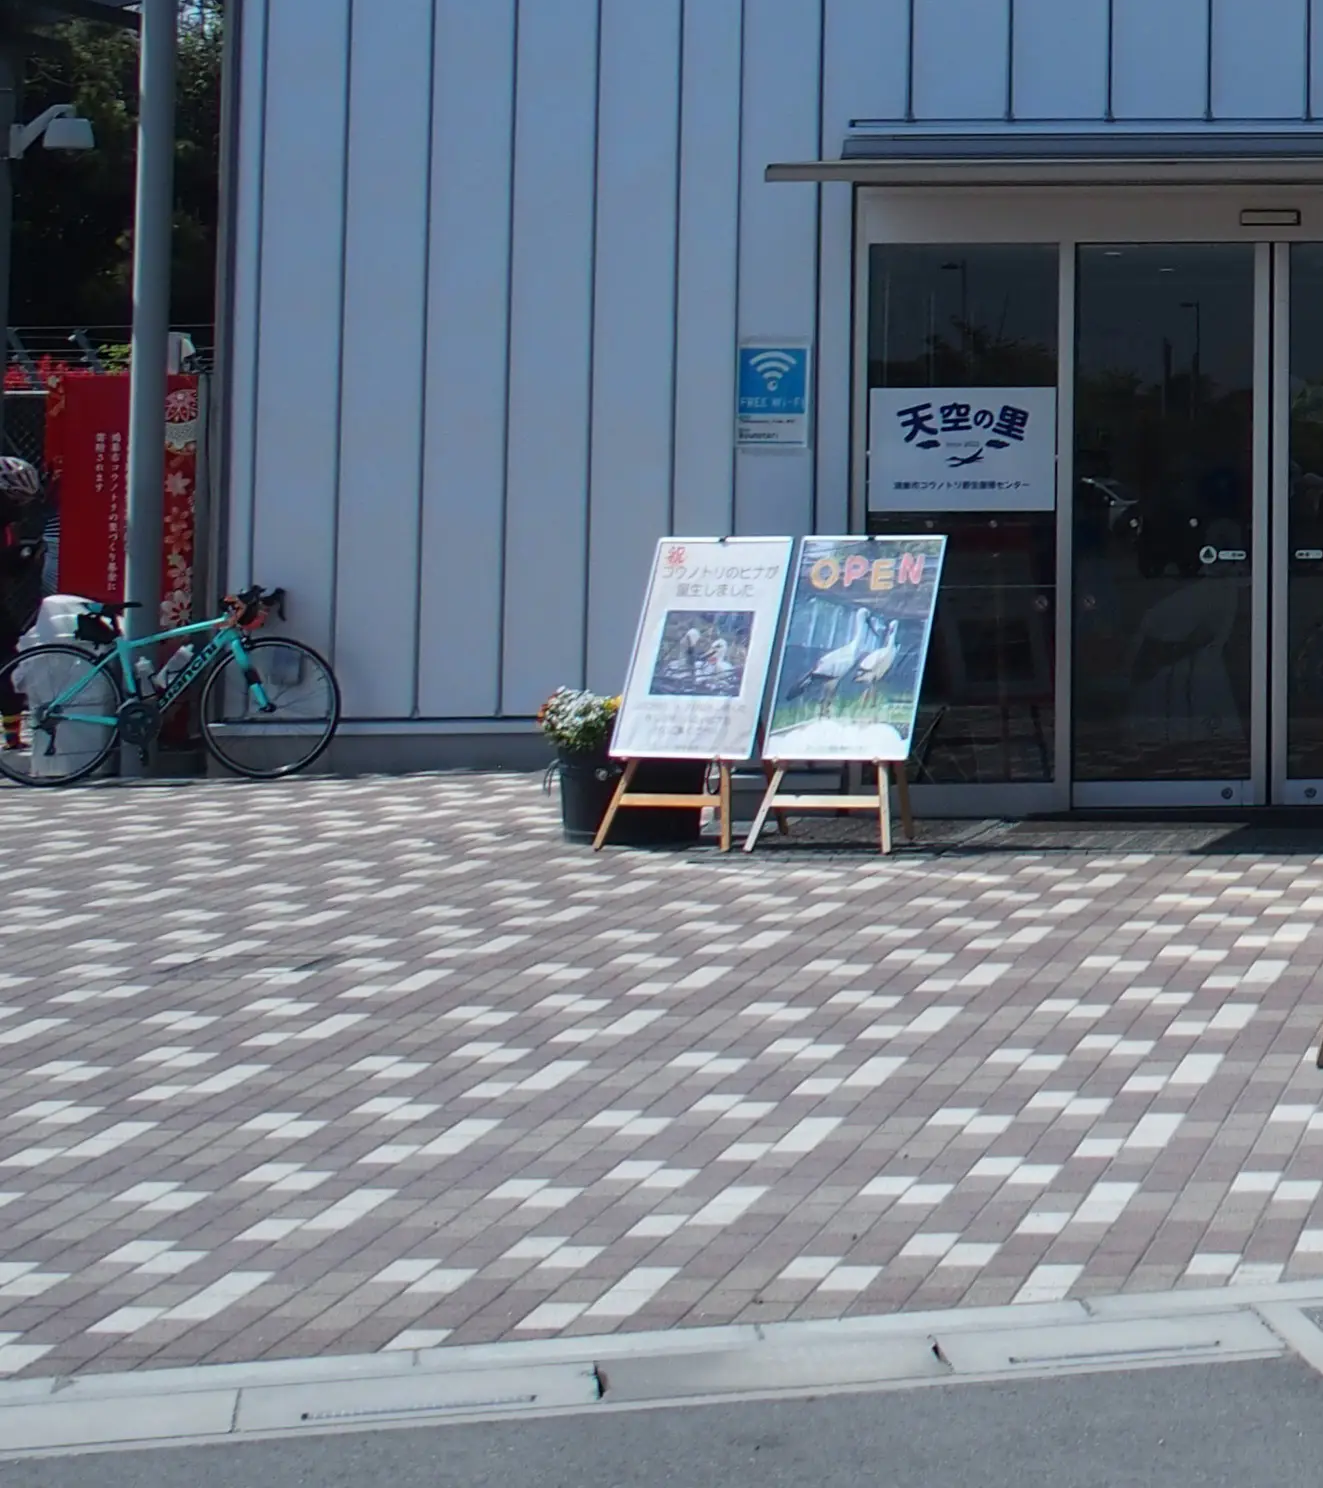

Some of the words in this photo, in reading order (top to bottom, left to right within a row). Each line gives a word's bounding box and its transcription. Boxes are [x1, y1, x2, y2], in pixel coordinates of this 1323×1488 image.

[739, 397, 768, 408] FREE
[897, 402, 1029, 443] 天空の里
[665, 546, 687, 565] 祝
[661, 565, 780, 580] コウノトリのヒナが
[810, 552, 926, 591] OPEN
[157, 643, 218, 708] Bianchi
